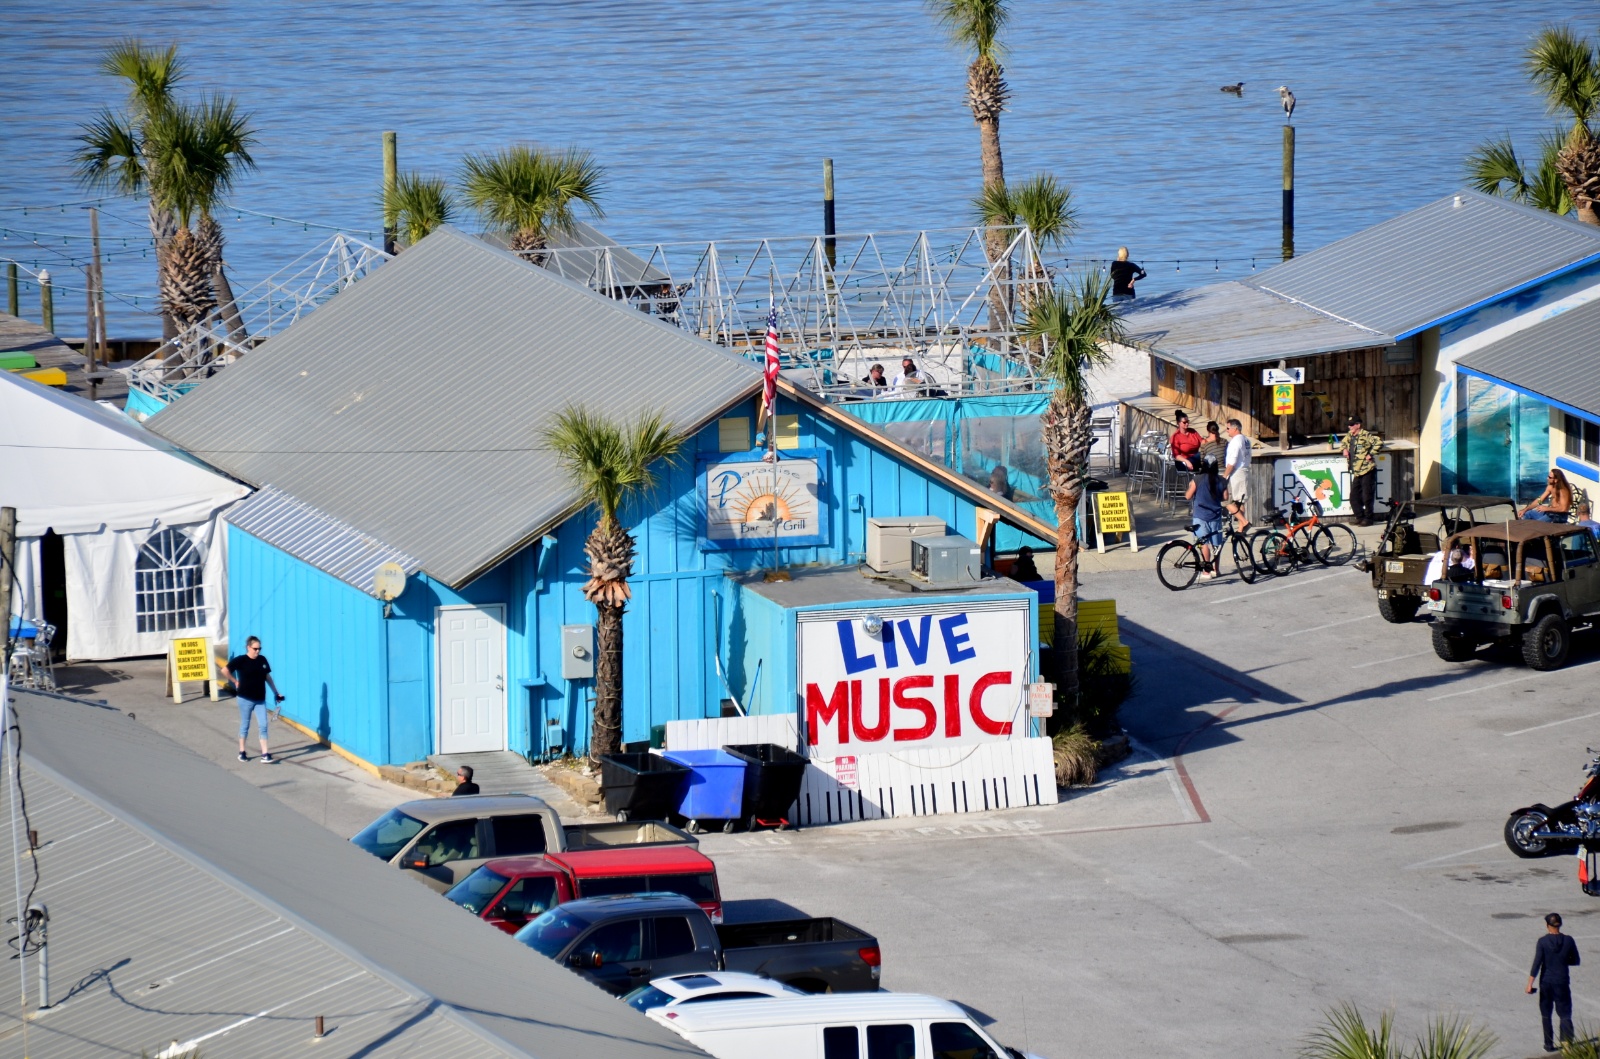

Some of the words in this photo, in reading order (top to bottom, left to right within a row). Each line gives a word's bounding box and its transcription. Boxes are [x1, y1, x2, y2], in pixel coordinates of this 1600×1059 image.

[712, 466, 800, 508] Paradise
[741, 522, 760, 533] Bar
[783, 520, 806, 530] Grill
[837, 612, 976, 675] LIVE
[806, 671, 1012, 746] MUSIC
